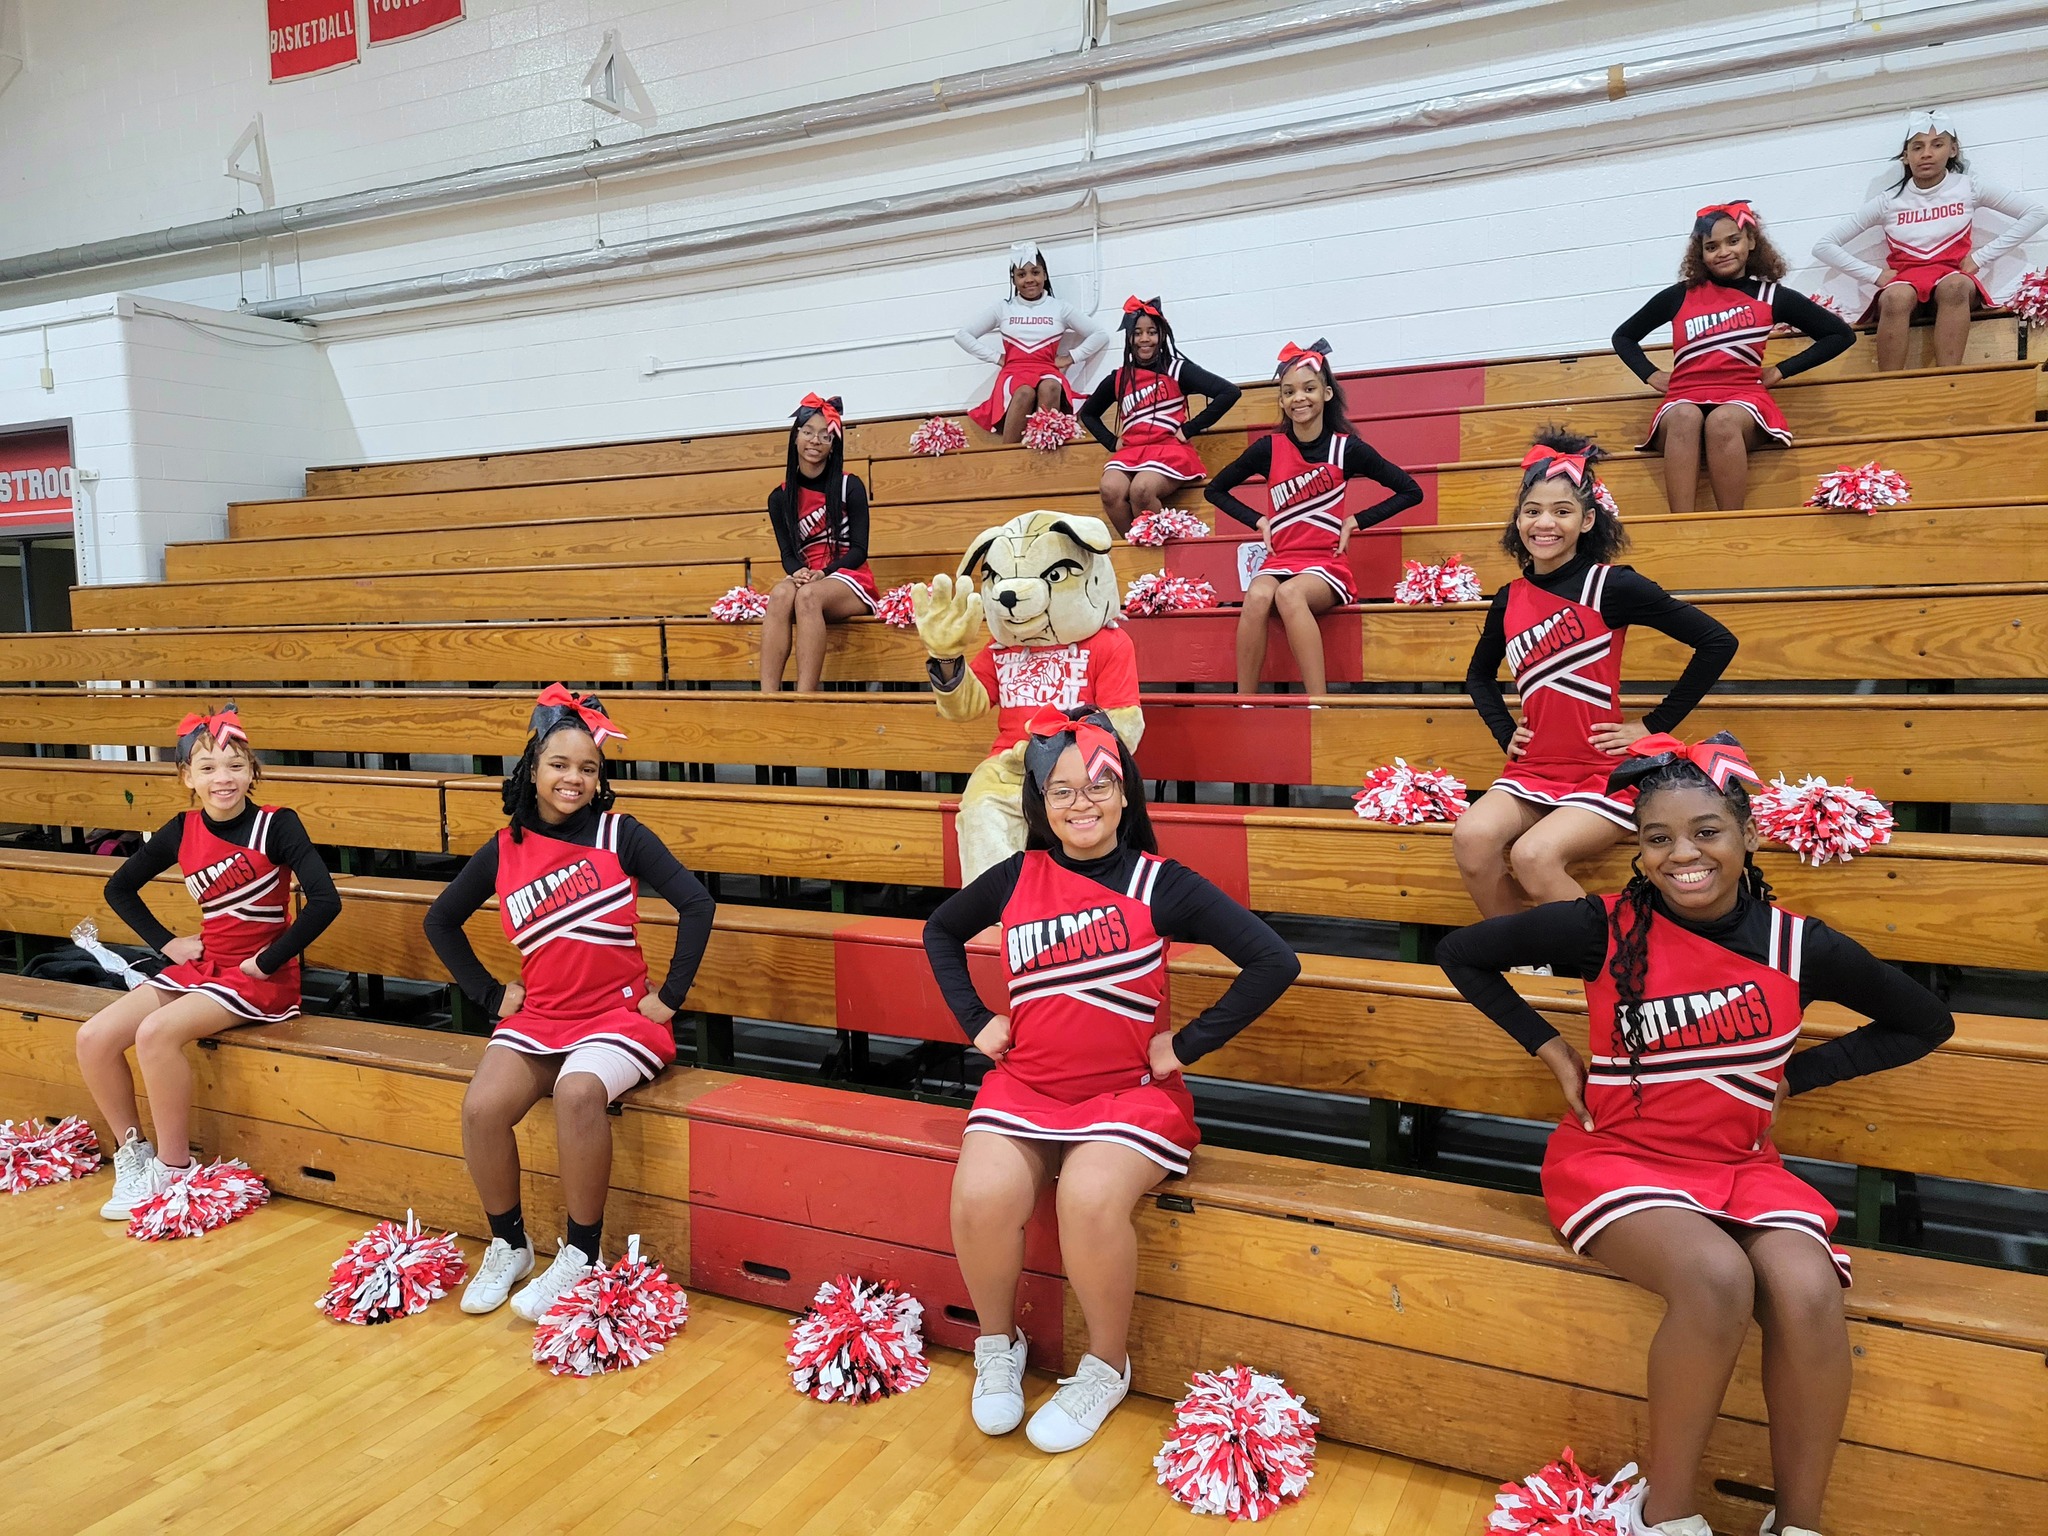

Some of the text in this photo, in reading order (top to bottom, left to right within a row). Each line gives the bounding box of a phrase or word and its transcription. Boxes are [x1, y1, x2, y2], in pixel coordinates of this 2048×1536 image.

[270, 10, 354, 54] BASKETBALL
[1896, 202, 1964, 226] BULLDOGS
[1009, 316, 1054, 326] BULLDOGS
[1684, 304, 1756, 341] BULLDOGS
[506, 859, 600, 931] BULLDOGS
[1006, 904, 1131, 975] BULLDOGS
